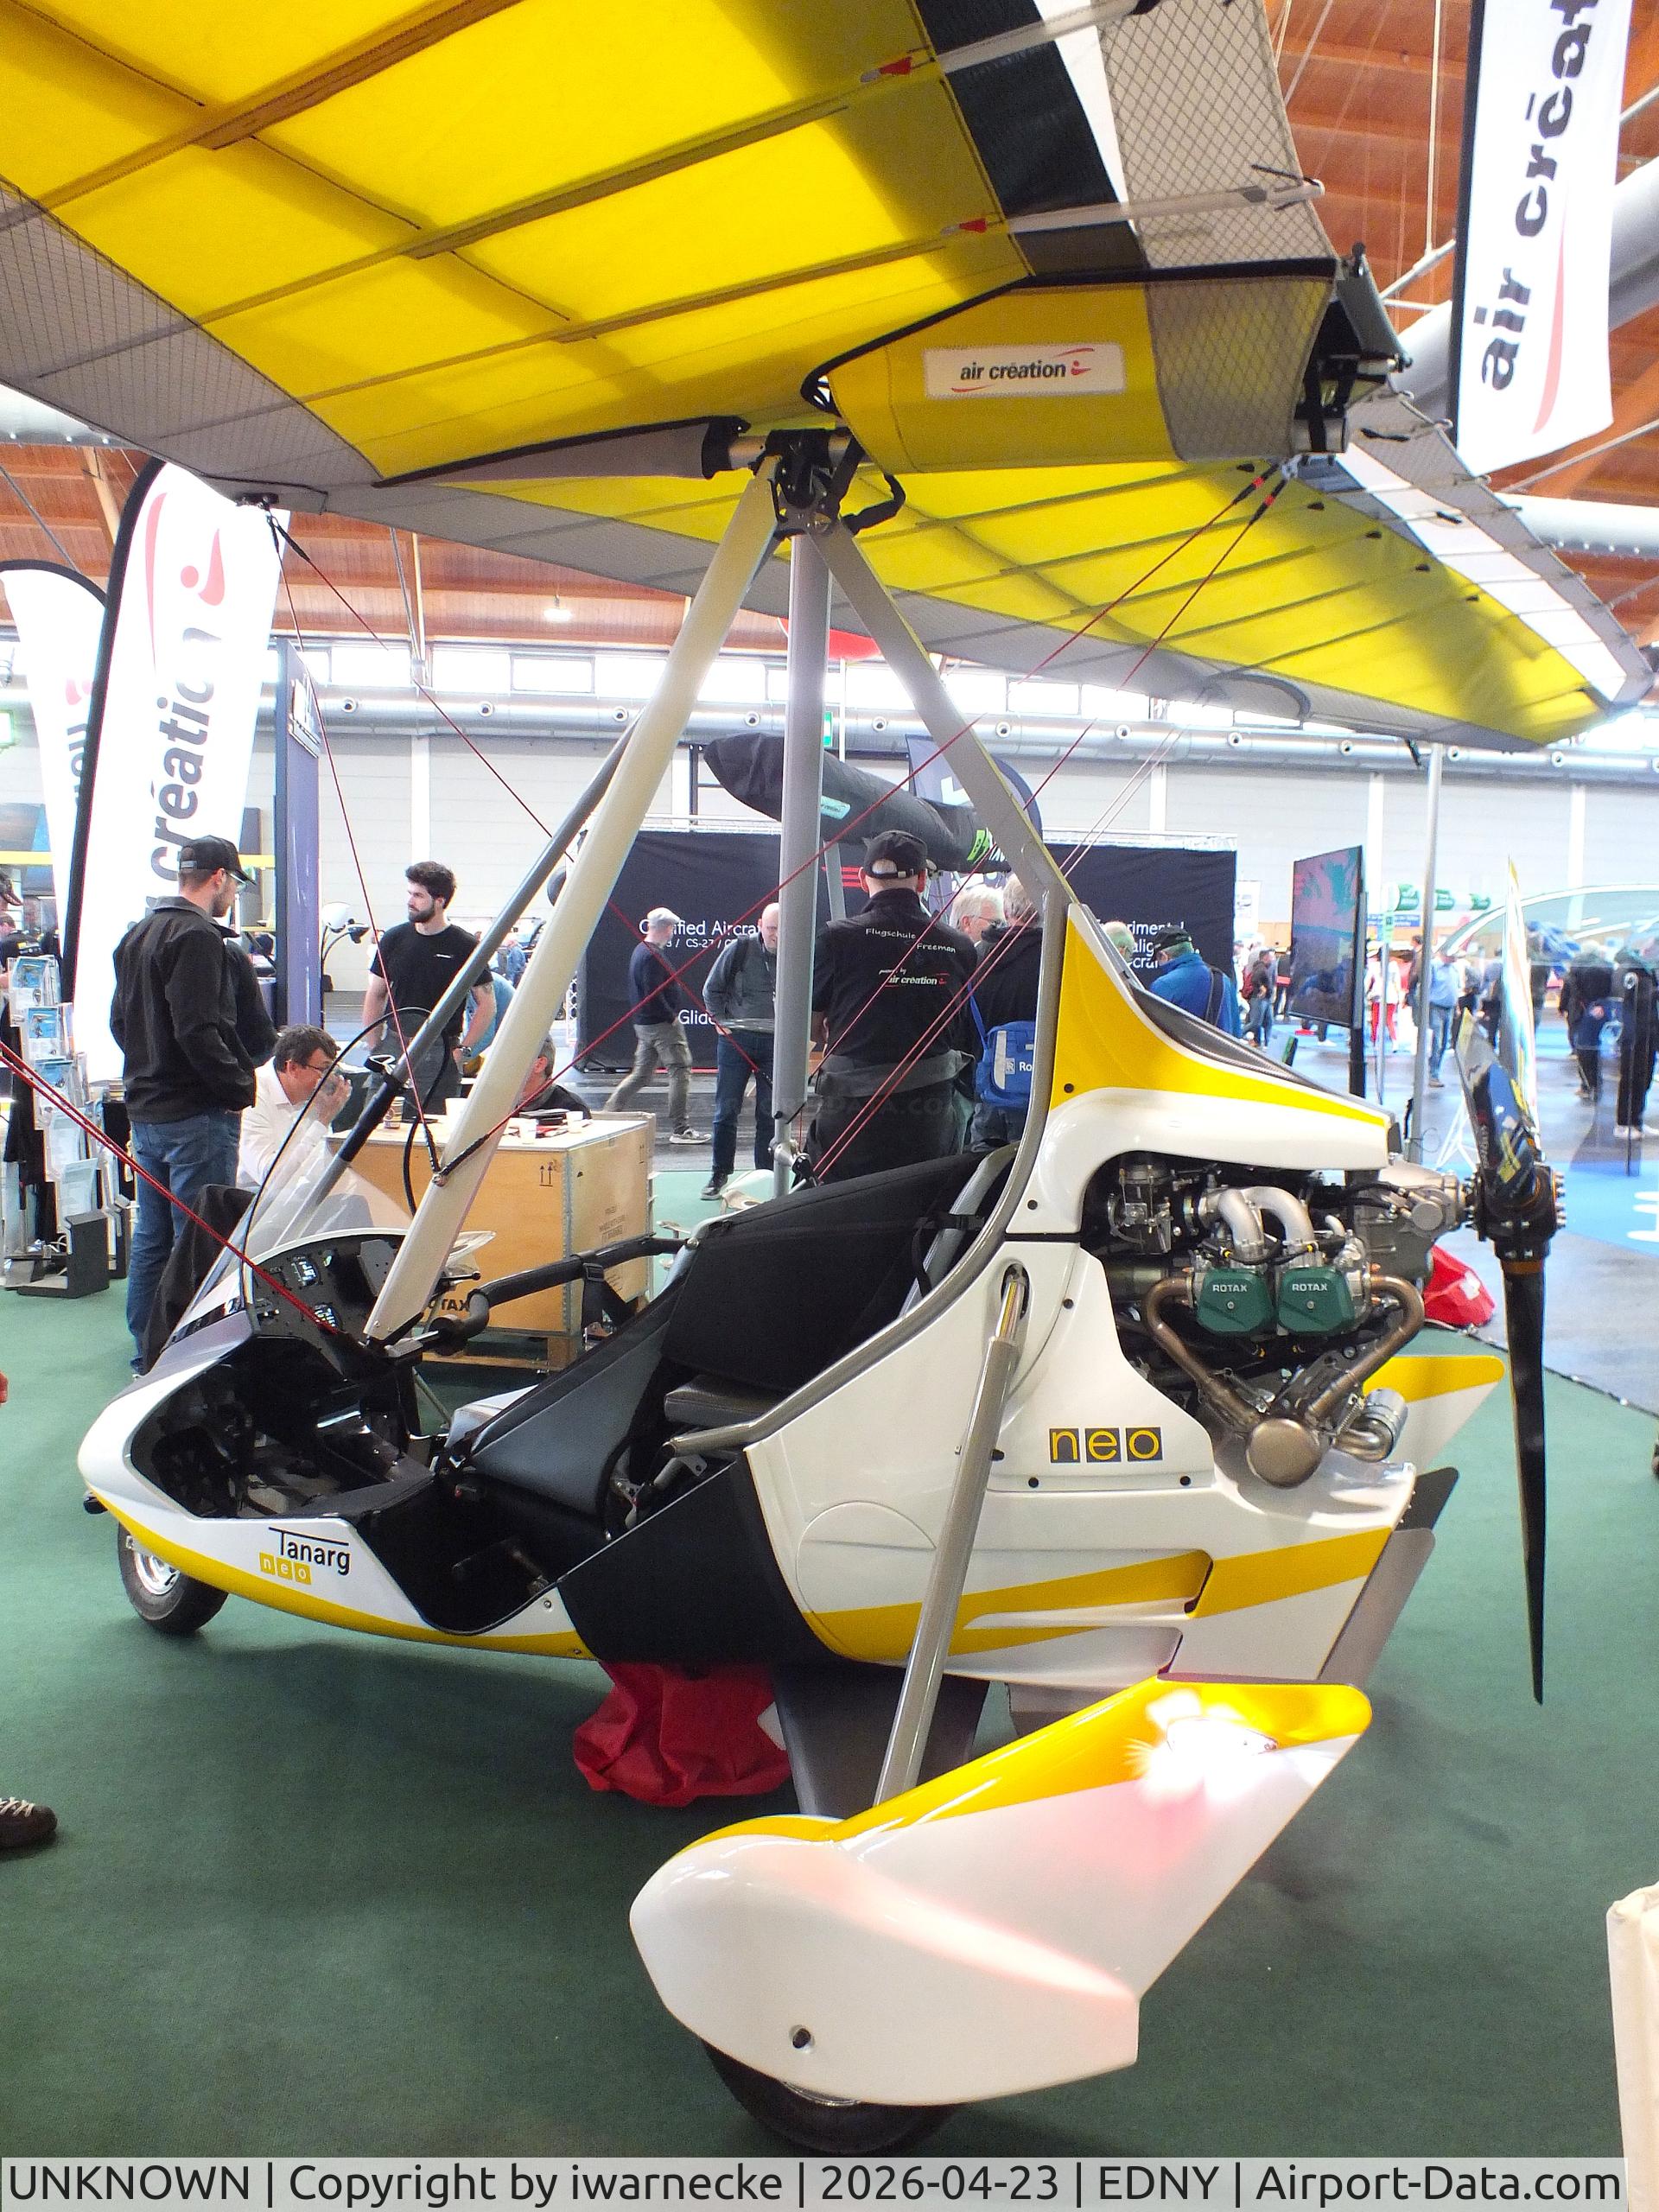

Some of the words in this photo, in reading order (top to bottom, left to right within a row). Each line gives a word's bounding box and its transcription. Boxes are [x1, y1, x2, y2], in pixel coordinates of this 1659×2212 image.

[1473, 267, 1531, 391] air
[960, 360, 984, 381] air
[711, 920, 760, 936] Aircra
[865, 927, 916, 939] Flugschule
[917, 943, 957, 953] Freeman
[1211, 1284, 1248, 1293] ROTAX
[1291, 1283, 1328, 1292] ROTAX
[1051, 1428, 1160, 1462] neo
[269, 1526, 351, 1576] Tanarg
[262, 1555, 308, 1581] neo
